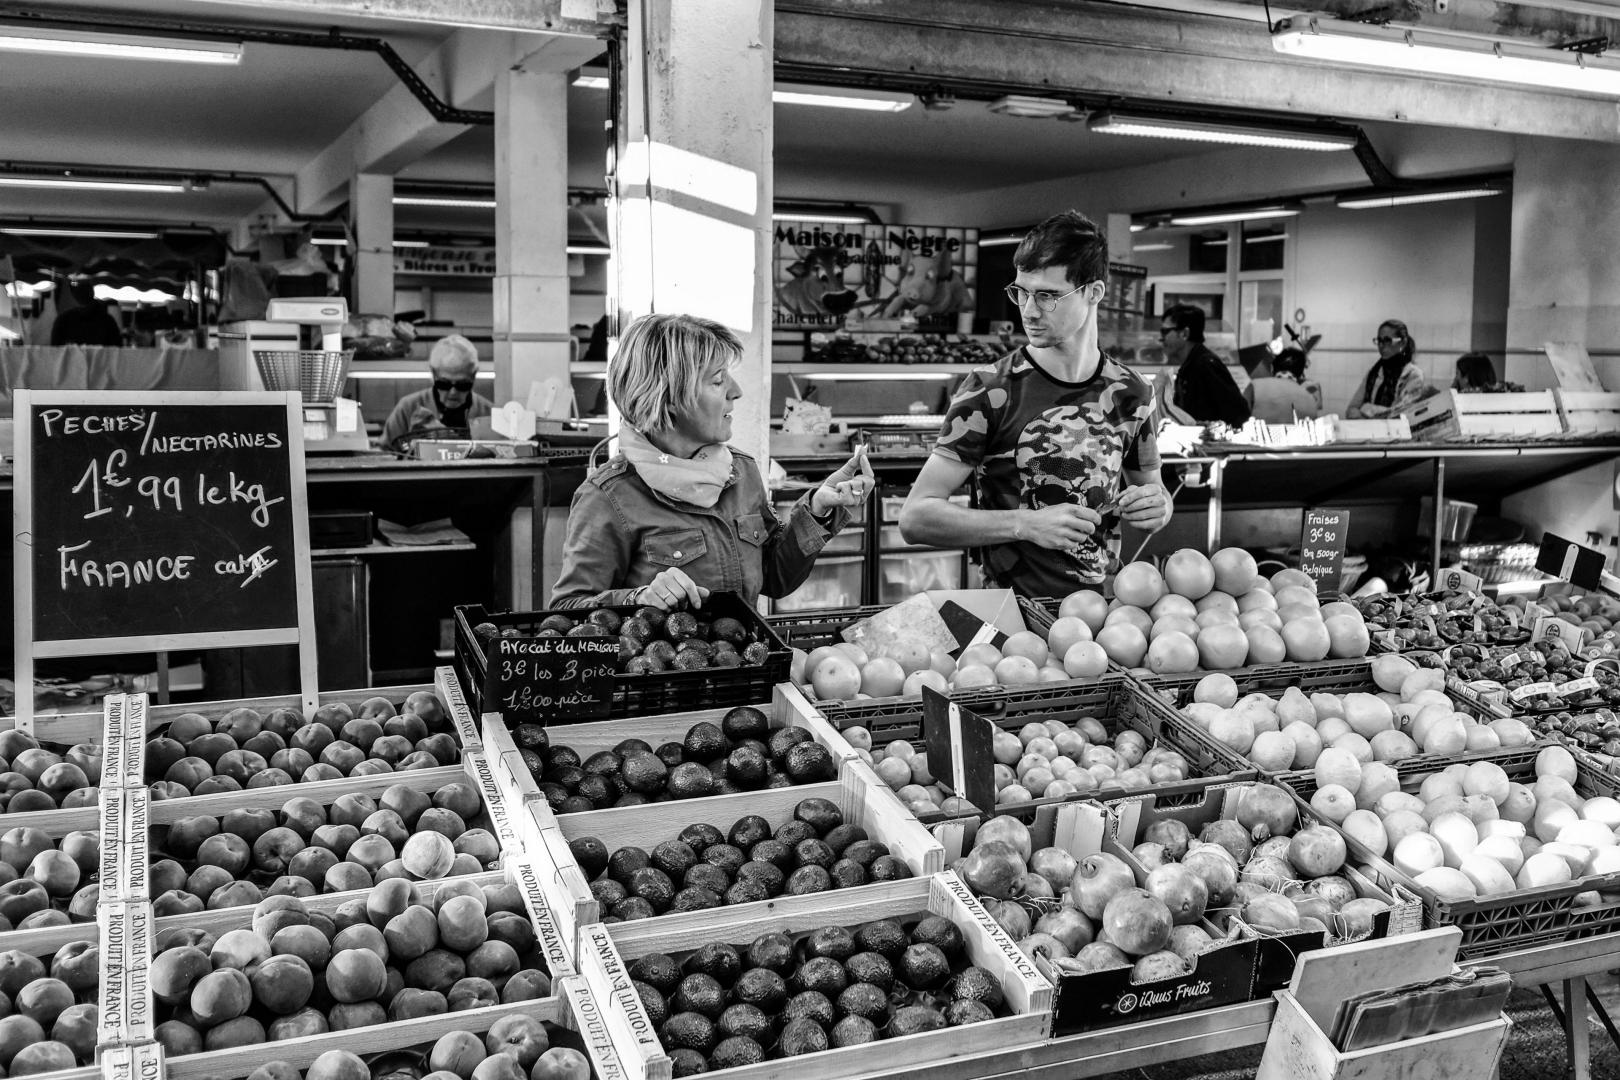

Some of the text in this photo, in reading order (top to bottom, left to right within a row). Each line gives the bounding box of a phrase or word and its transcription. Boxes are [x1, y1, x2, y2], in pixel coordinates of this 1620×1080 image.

[773, 225, 961, 258] Maison Nègre
[1308, 513, 1340, 525] Fraises
[57, 540, 195, 590] FRANCE
[1302, 563, 1334, 577] Belgique
[556, 639, 577, 654] du
[534, 662, 553, 681] les
[560, 660, 578, 681] 3
[108, 702, 122, 736] PRODUIT
[105, 746, 120, 778] FRANCE
[105, 798, 120, 838] PRODUIT
[132, 796, 146, 830] FRANCE
[102, 853, 118, 890] FRANCE
[130, 845, 144, 888] PRODUIT
[132, 912, 146, 956] FRANCE
[519, 864, 544, 906] PRODUIT
[538, 921, 566, 964] FRANCE
[946, 880, 990, 922] PRODUIT
[994, 935, 1037, 980] FRANCE
[108, 914, 124, 962] PRODUIT
[592, 932, 622, 975] FRANCE
[104, 980, 122, 1028] FRANCE
[130, 973, 146, 1026] PRODUIT
[1175, 980, 1212, 1000] Fruits
[574, 988, 608, 1042] PRODUIT
[618, 994, 654, 1044] PRODUIT
